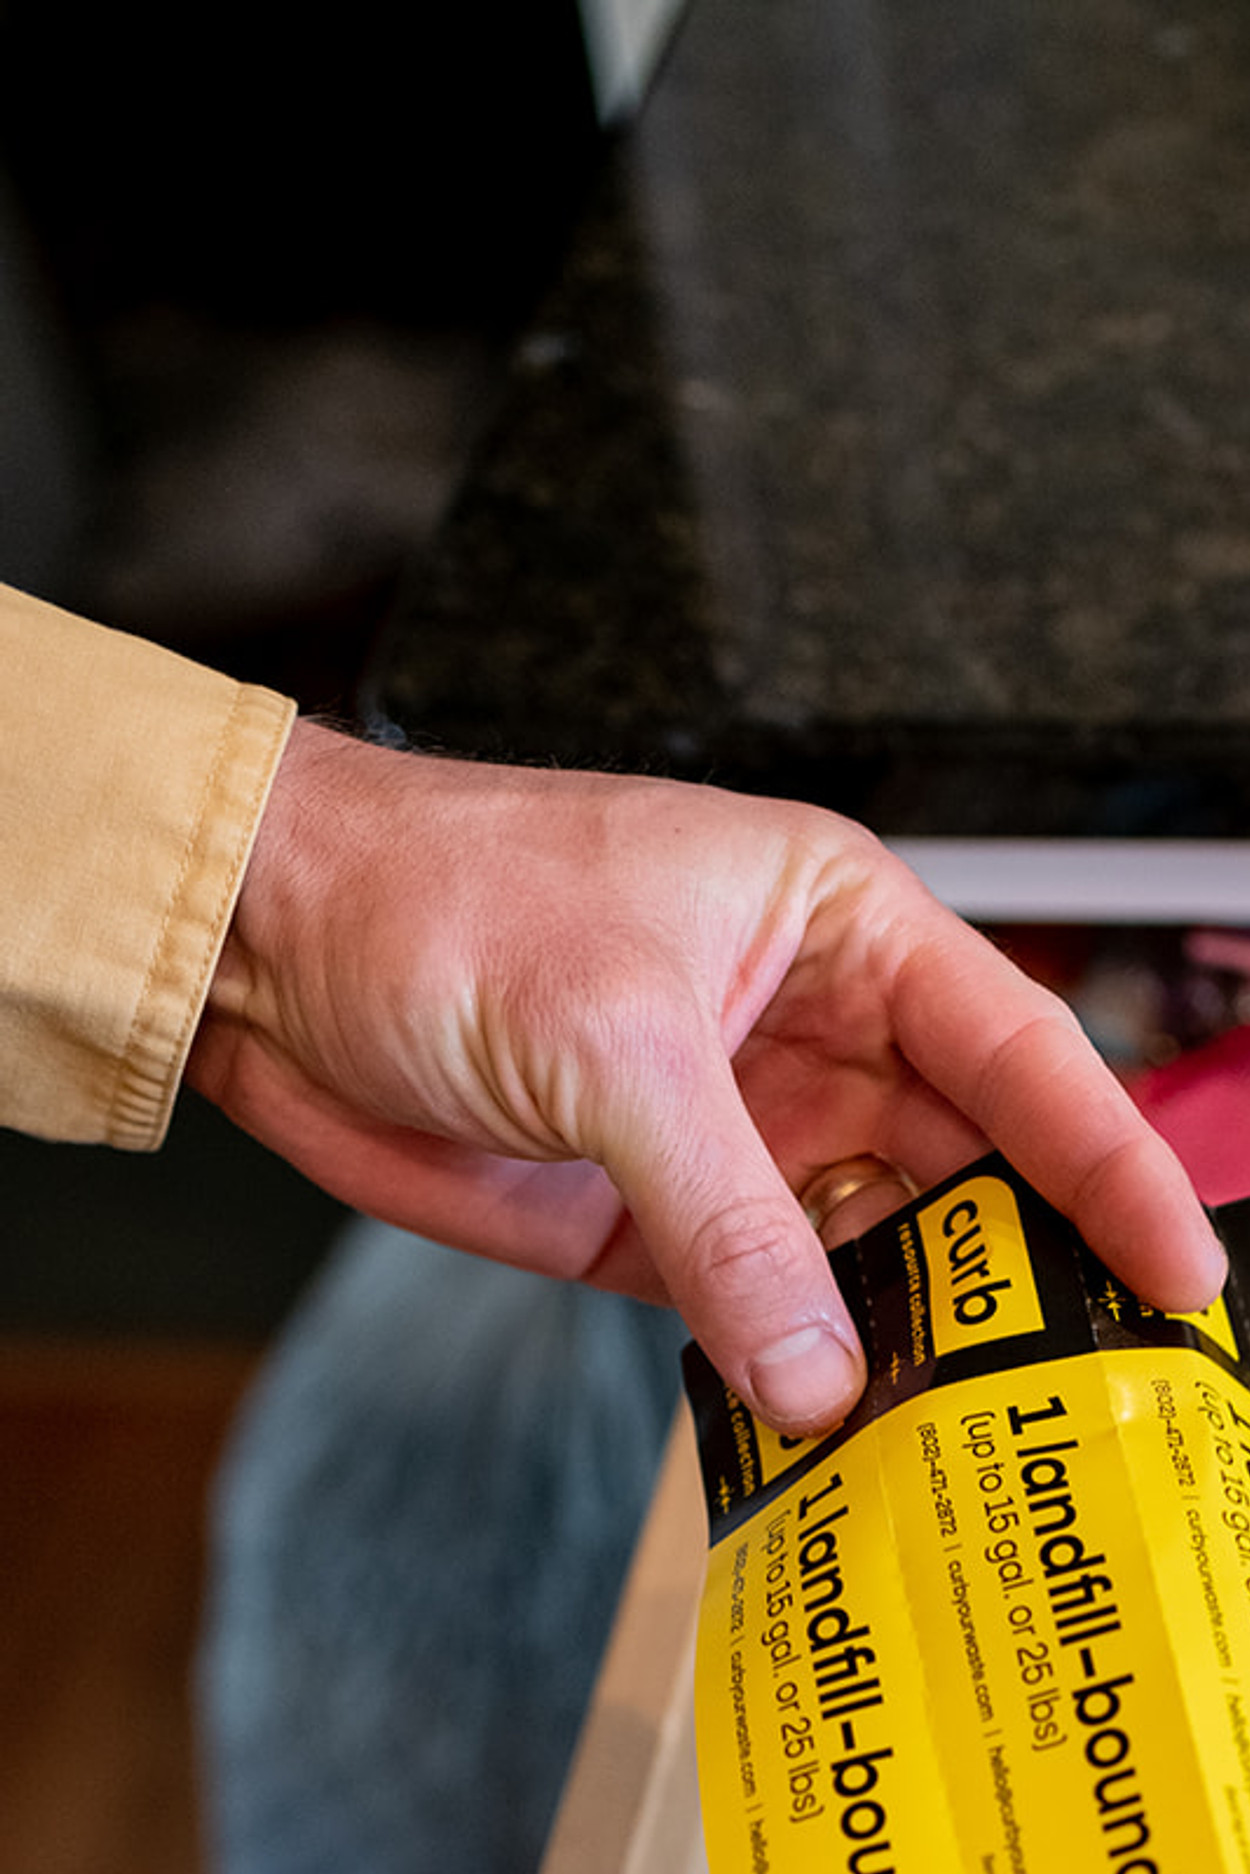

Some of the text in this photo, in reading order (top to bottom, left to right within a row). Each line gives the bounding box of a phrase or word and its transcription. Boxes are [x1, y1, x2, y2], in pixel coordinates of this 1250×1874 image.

[897, 1221, 927, 1368] resource collection
[942, 1199, 1013, 1326] curb
[1006, 1395, 1068, 1436] 1
[1212, 1433, 1237, 1467] to
[798, 1472, 843, 1521] 1
[1220, 1469, 1250, 1507] 15
[916, 1422, 958, 1538] (802)-471-2872
[947, 1559, 995, 1723] curbyourwaste.com
[960, 1410, 1069, 1752] (up to 15 gal. or 25 lbs)
[1185, 1508, 1232, 1667] curbyourwaste.com
[760, 1508, 826, 1824] (up to 15 gal. or 25 lbs)
